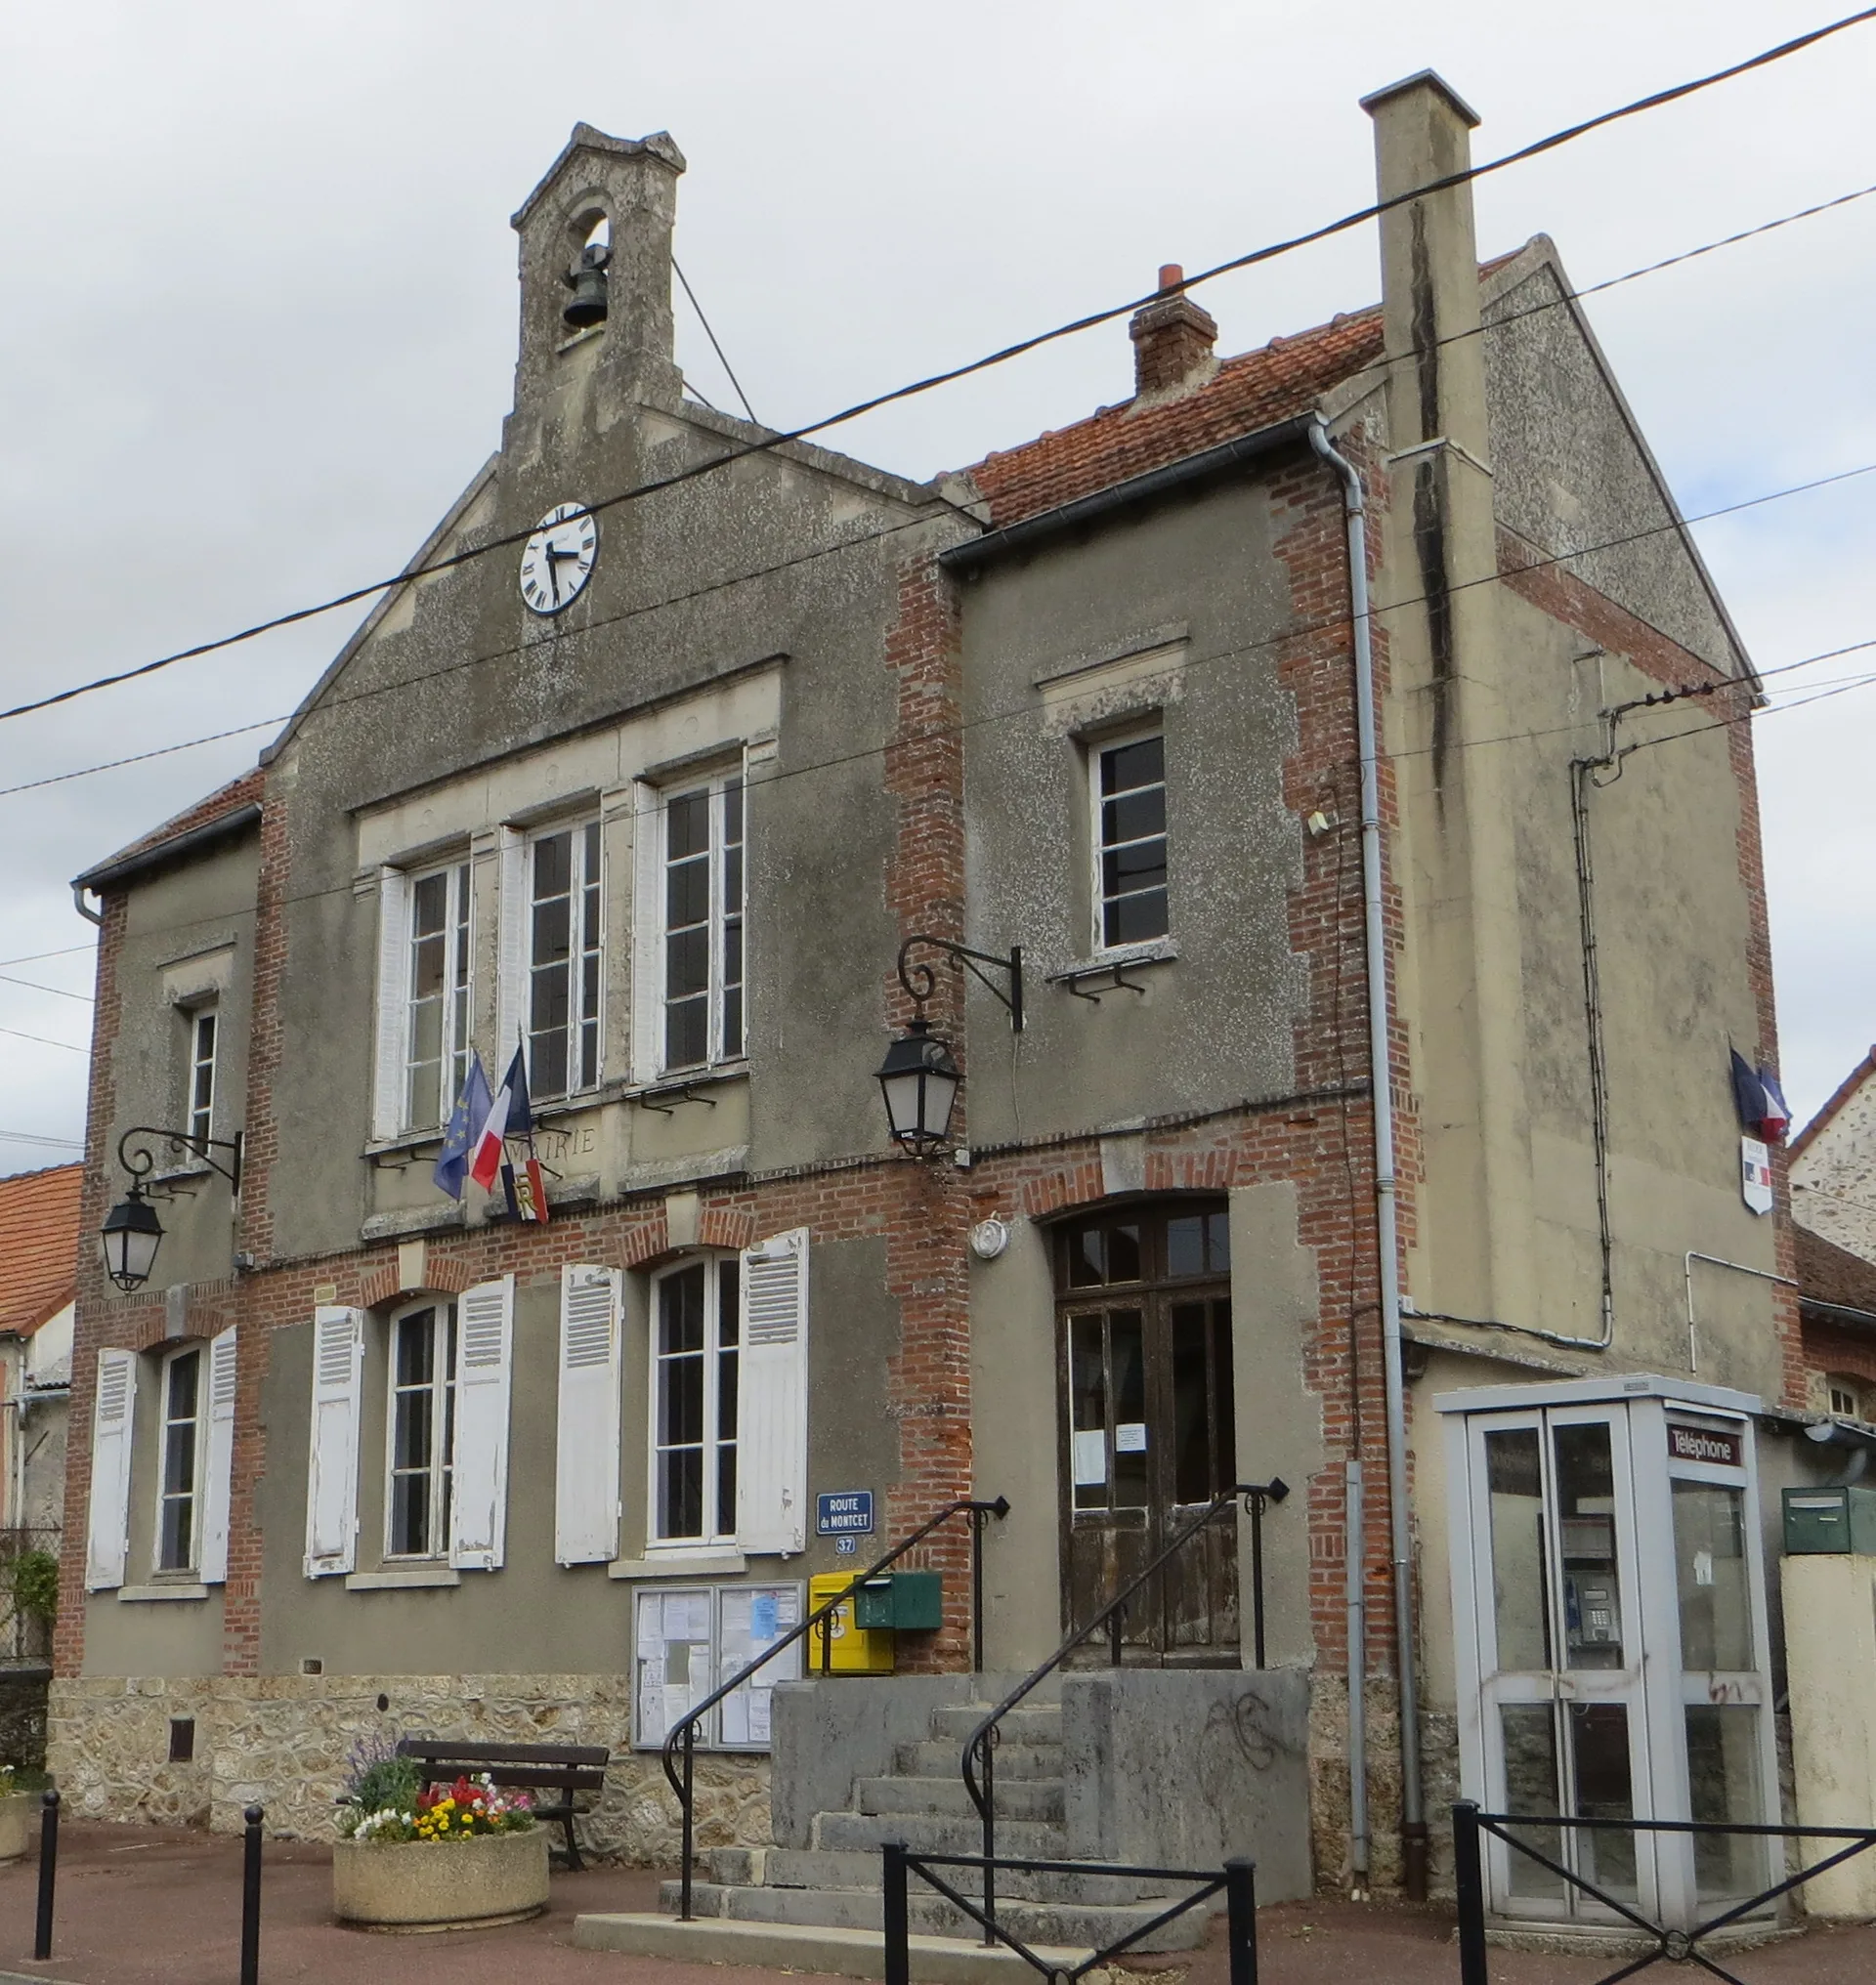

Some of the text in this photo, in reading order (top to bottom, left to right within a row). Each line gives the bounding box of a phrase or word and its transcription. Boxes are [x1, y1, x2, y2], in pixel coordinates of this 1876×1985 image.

[527, 541, 539, 554] X
[581, 536, 595, 551] III
[1672, 1429, 1732, 1460] Téléphone
[830, 1498, 859, 1511] ROUTE
[831, 1513, 868, 1528] MONTCET
[837, 1539, 853, 1551] 37
